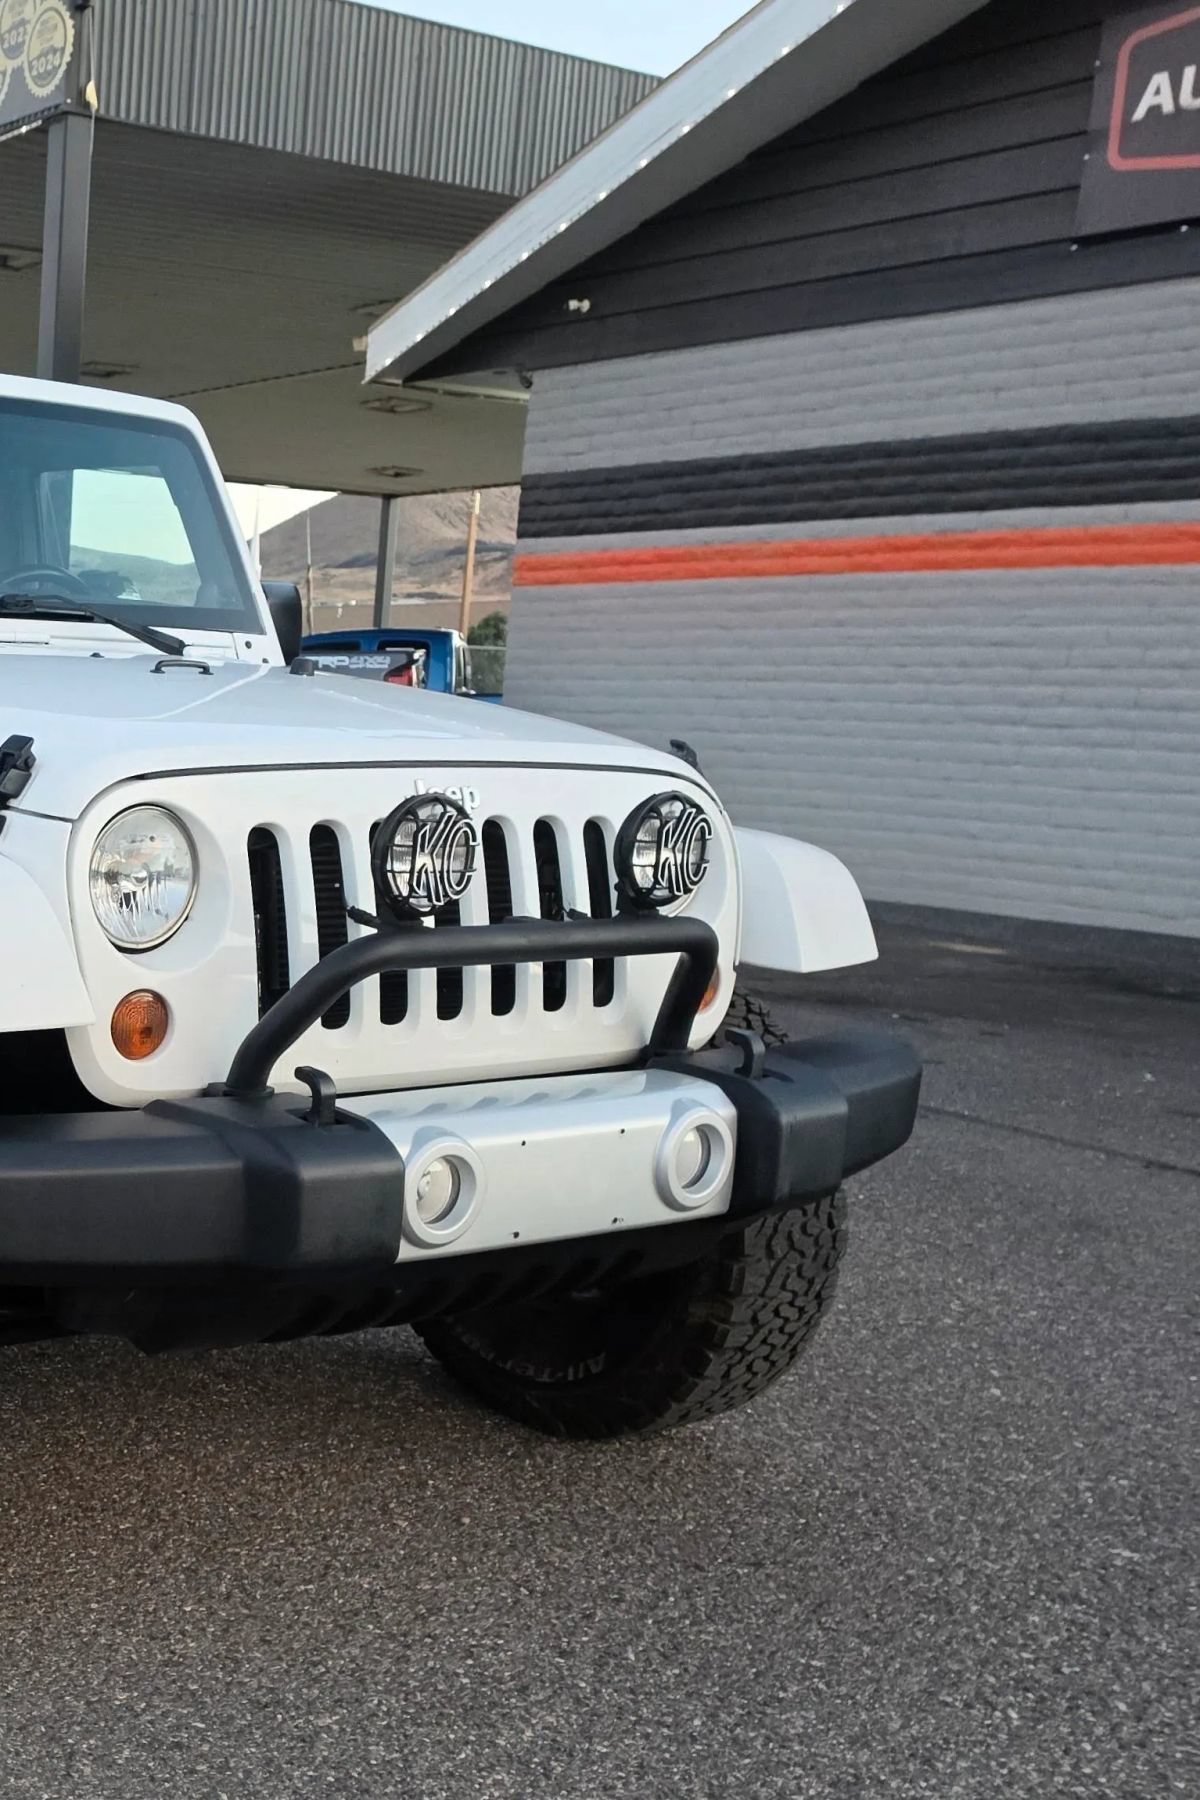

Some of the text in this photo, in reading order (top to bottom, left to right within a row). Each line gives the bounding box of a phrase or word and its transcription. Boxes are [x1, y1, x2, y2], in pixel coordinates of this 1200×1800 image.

[30, 52, 62, 76] 2024
[412, 810, 479, 906] KC
[658, 808, 714, 896] KC
